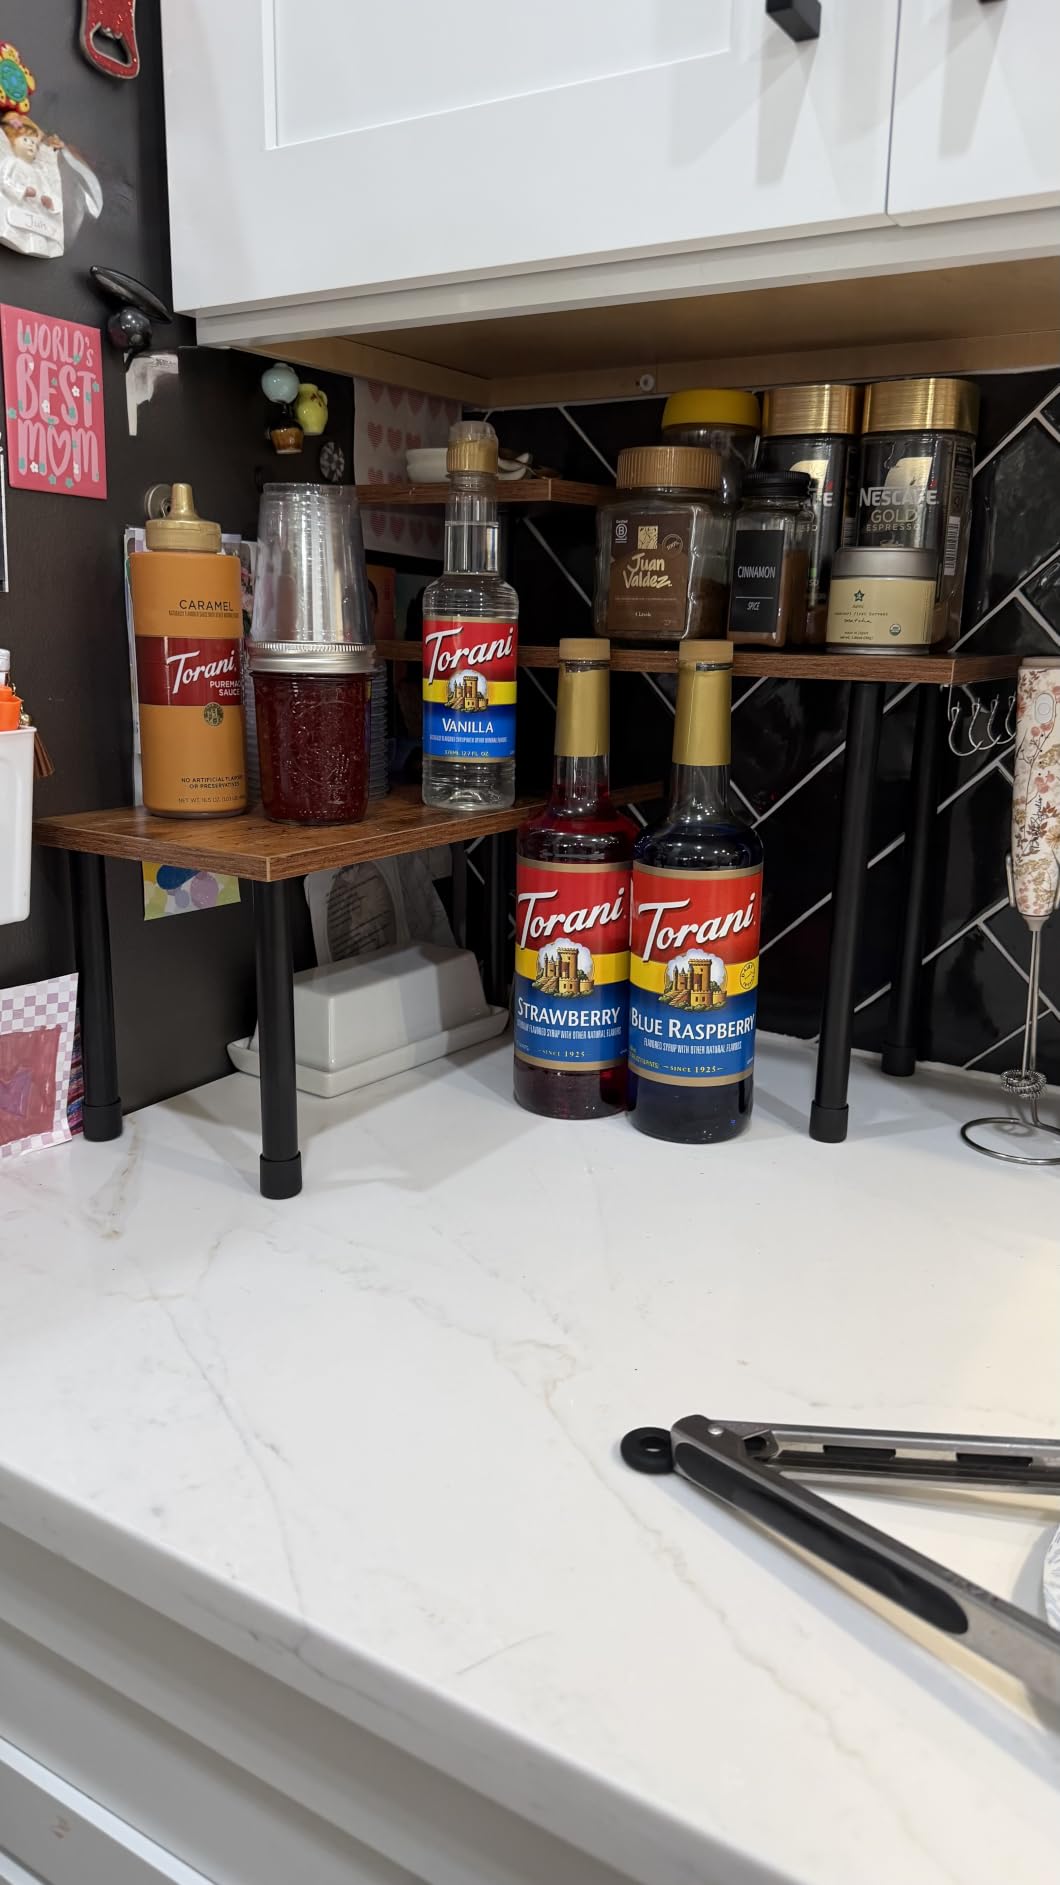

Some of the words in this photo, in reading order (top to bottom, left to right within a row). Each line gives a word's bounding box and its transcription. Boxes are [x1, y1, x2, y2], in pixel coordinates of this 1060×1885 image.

[17, 319, 93, 367] WORLD'S
[16, 353, 96, 427] BEST
[871, 509, 918, 523] GOLD
[866, 523, 921, 531] ESPRESSO
[627, 552, 665, 572] Juan
[623, 570, 671, 589] Valdez
[737, 566, 776, 579] CINNAMON
[179, 600, 234, 612] CARAMEL
[747, 601, 760, 611] SPICE
[425, 626, 513, 685] Torani
[166, 650, 235, 694] Torani
[218, 688, 241, 696] SAUCE
[442, 718, 494, 733] VANILLA
[518, 887, 625, 949] Torani
[638, 892, 756, 963] Torani
[518, 996, 621, 1027] STRAWBERRY
[631, 1007, 663, 1036] BLUE
[668, 1013, 756, 1041] RASPBERRY
[565, 1050, 585, 1058] 1925
[670, 1065, 691, 1073] SINCE
[694, 1065, 716, 1073] 1925
